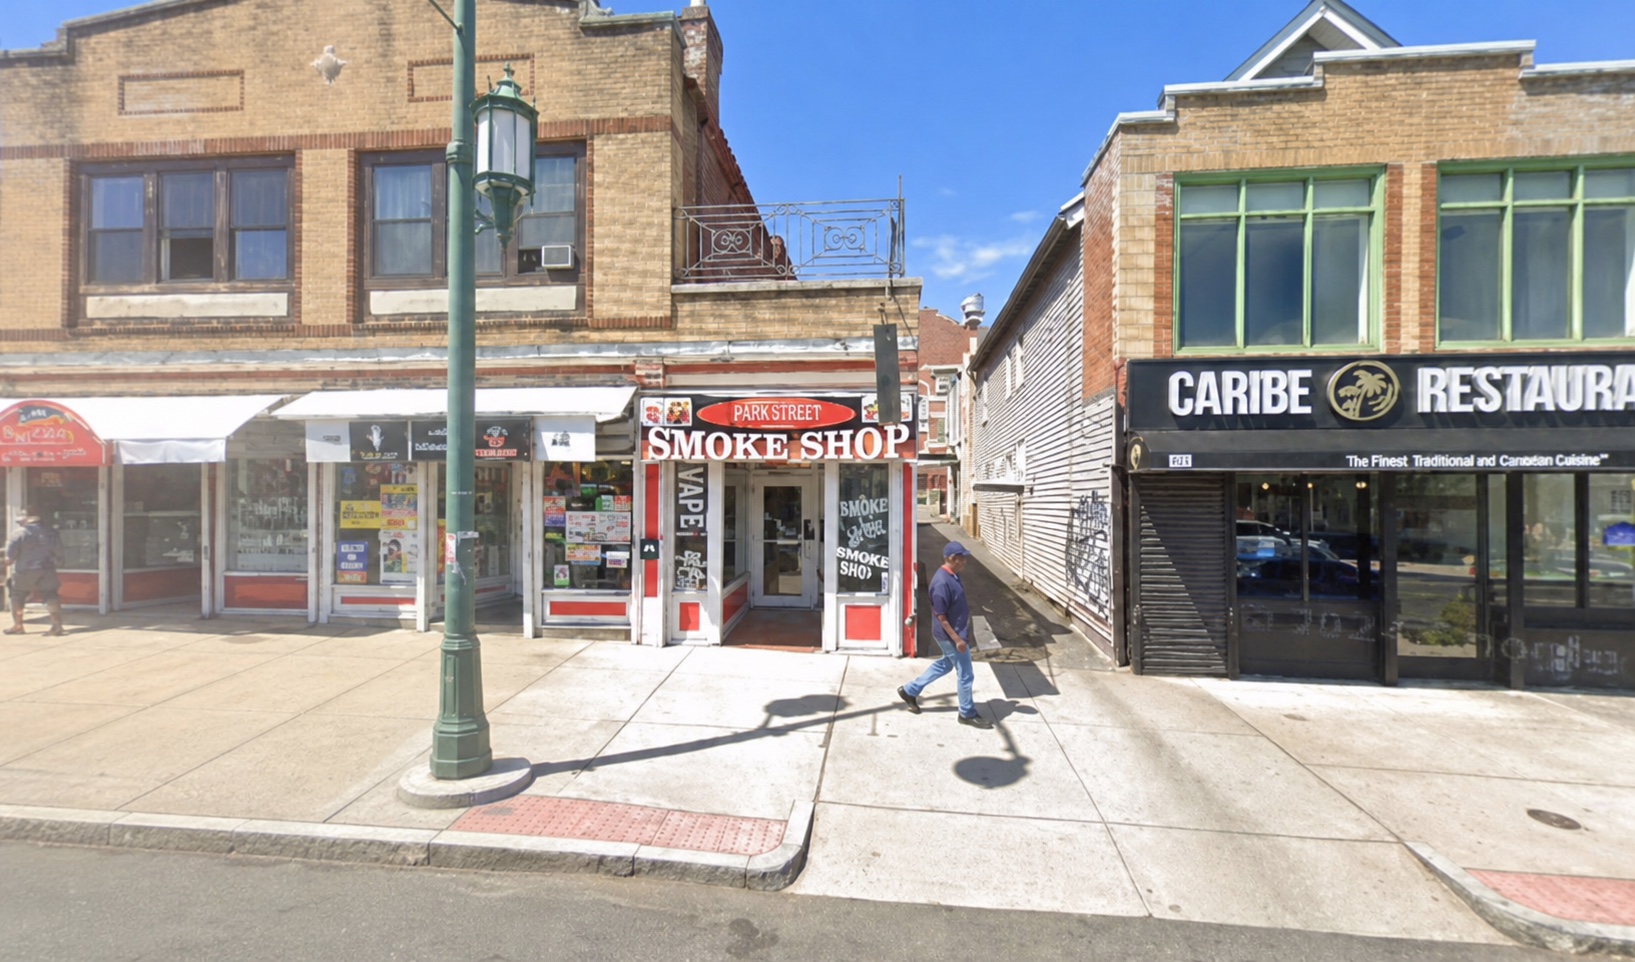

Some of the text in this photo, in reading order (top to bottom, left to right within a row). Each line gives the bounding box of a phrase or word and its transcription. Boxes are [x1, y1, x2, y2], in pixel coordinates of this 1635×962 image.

[1169, 364, 1635, 416] CARIBE RESTAURA
[734, 403, 822, 422] PARK STREET
[648, 423, 910, 460] SMOKE SHOP
[1346, 455, 1369, 467] The
[1371, 455, 1408, 467] Finest
[1412, 454, 1474, 467] Traditional
[1476, 455, 1496, 467] and
[678, 467, 704, 528] VAPE
[836, 546, 889, 569] SMOKE
